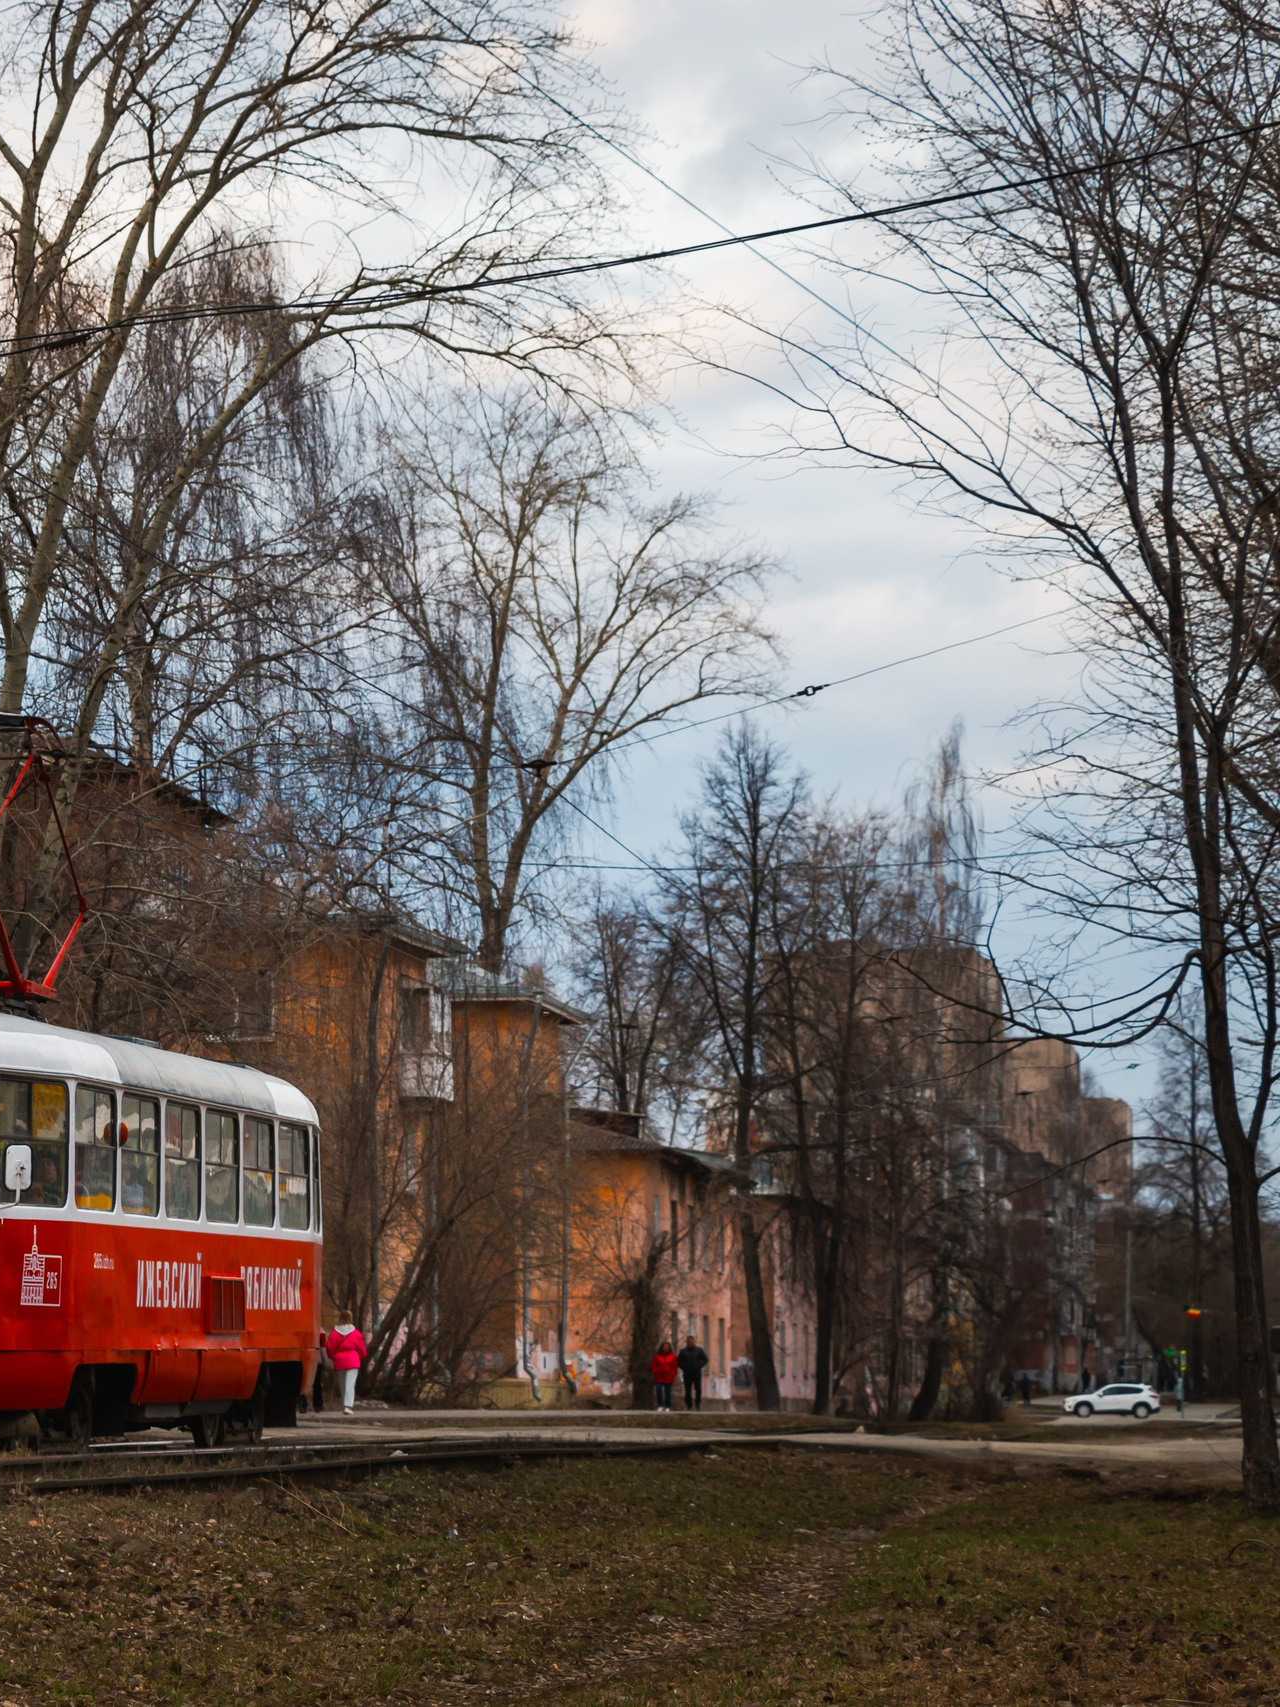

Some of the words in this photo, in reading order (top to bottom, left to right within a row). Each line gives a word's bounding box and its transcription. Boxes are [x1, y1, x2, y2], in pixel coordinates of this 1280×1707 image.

[46, 1272, 58, 1289] 265
[136, 1252, 202, 1308] ИЖЕВСКИЙ
[240, 1259, 302, 1310] ЯБИНОВЫЙ
